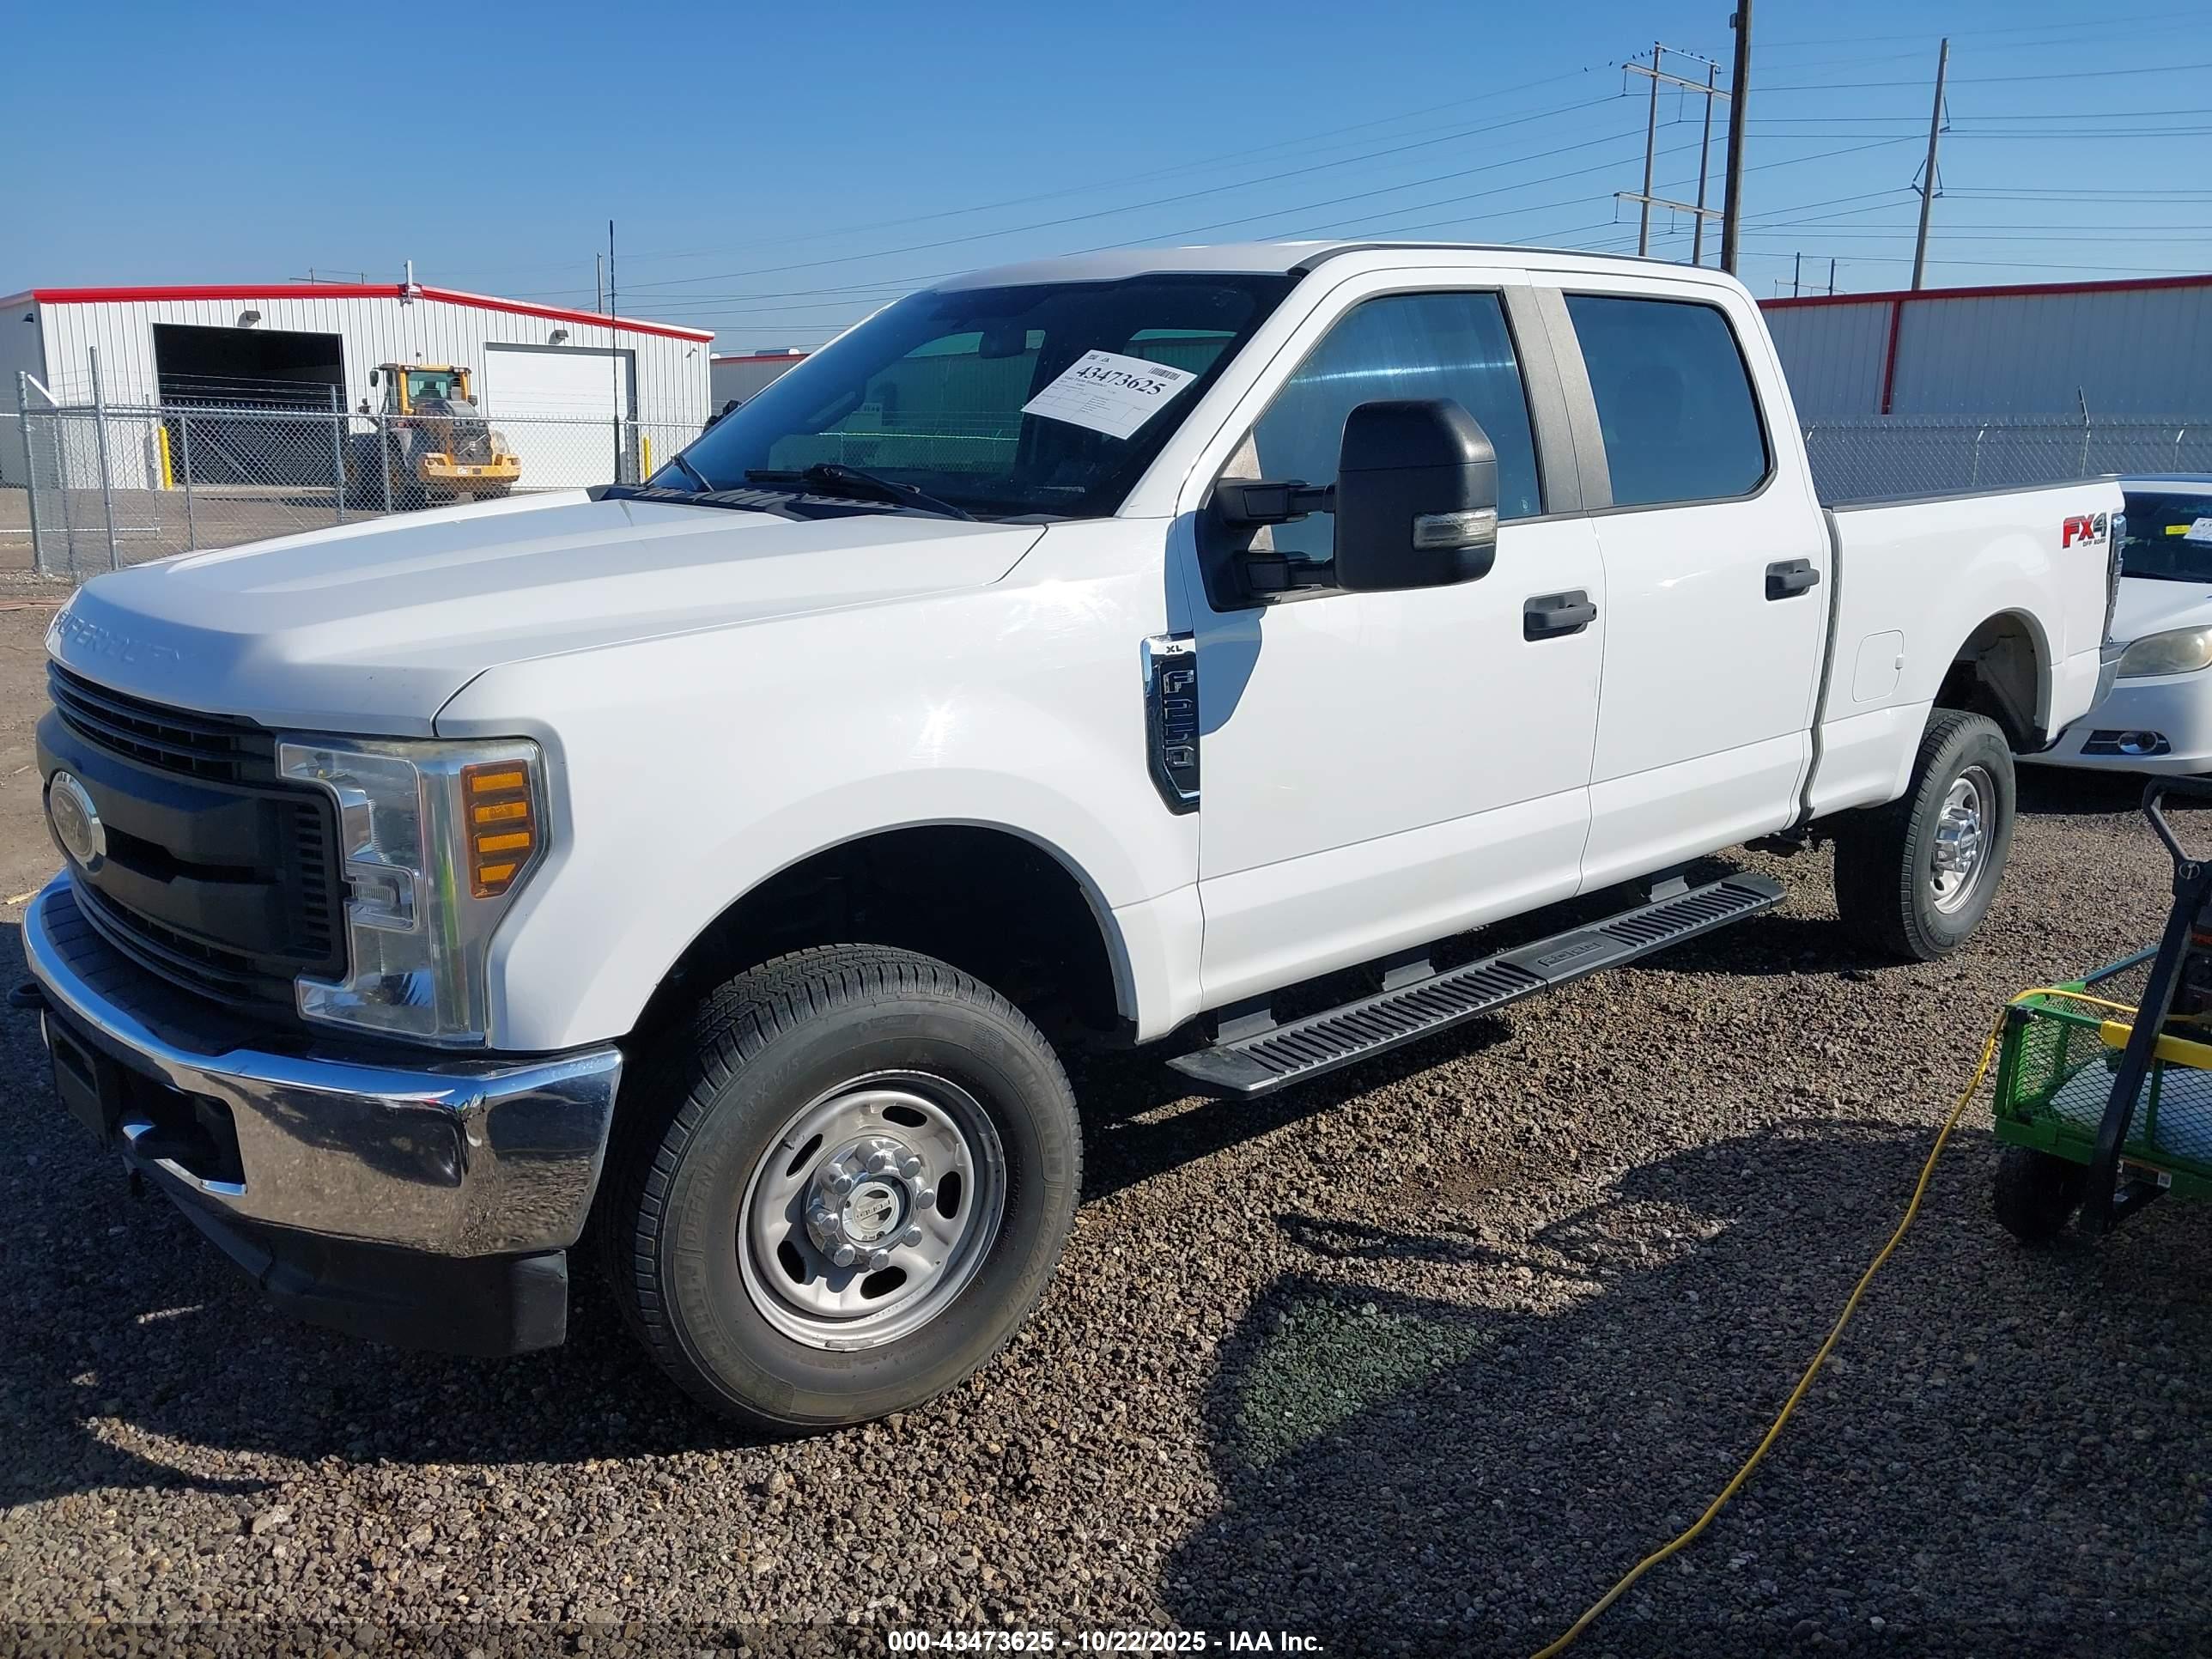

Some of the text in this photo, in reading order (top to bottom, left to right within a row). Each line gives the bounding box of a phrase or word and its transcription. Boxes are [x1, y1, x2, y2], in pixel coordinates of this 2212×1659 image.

[1076, 366, 1168, 395] 43473625
[2063, 513, 2107, 549] FX4
[1166, 645, 1183, 653] XL
